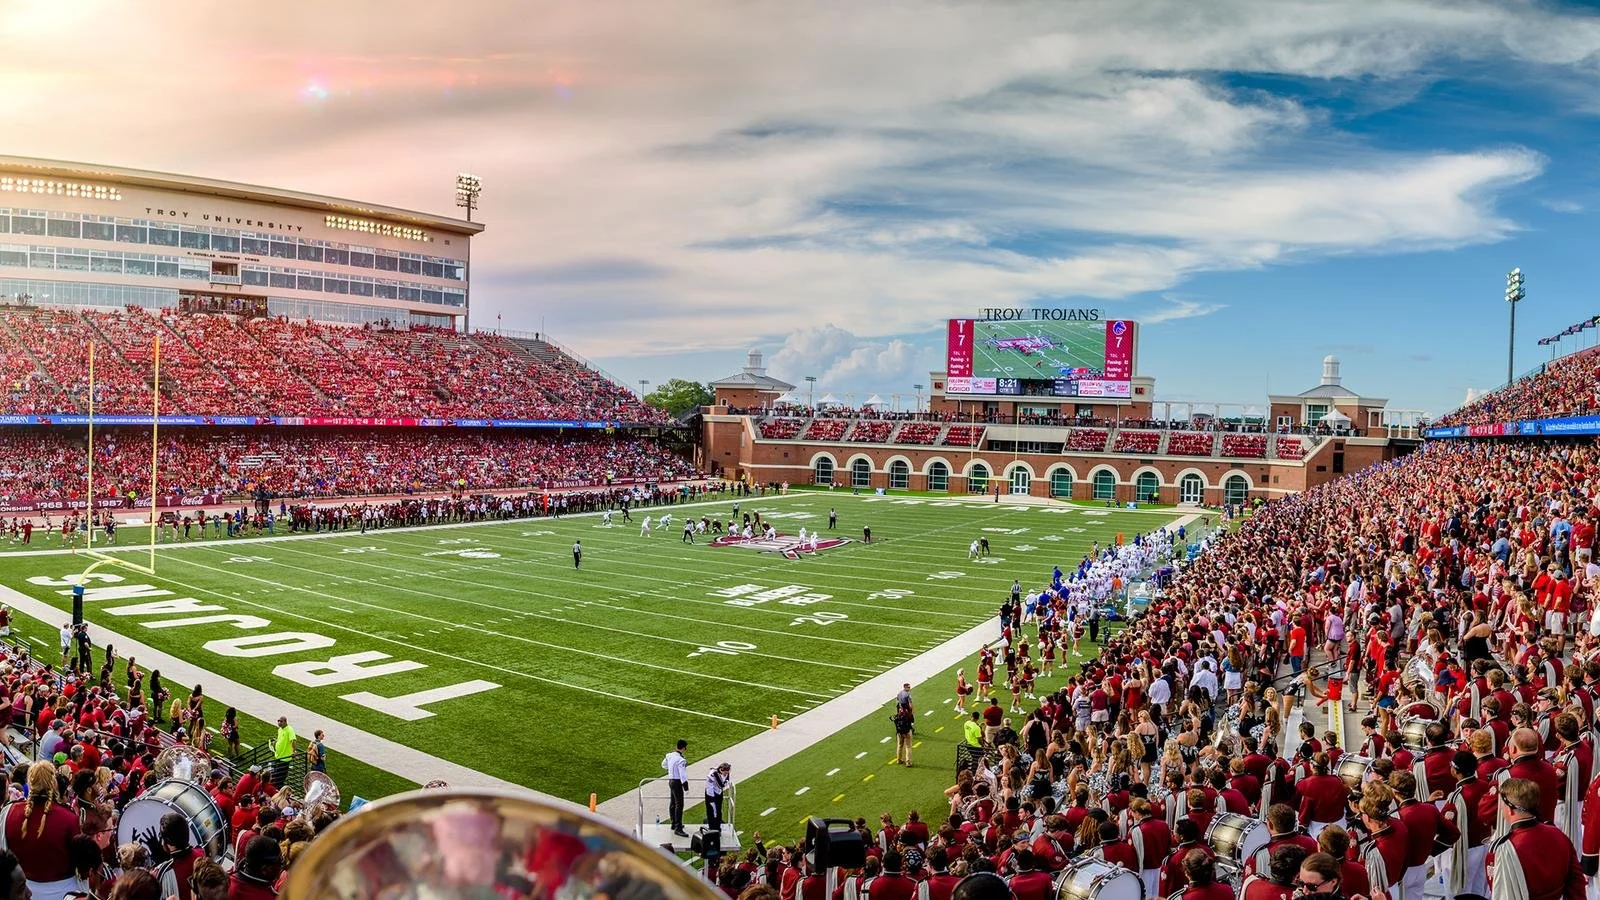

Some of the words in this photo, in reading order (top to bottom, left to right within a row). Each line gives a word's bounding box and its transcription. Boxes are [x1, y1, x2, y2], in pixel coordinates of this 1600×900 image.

[145, 208, 189, 218] TROY
[203, 214, 303, 232] UNIVERSITY
[984, 308, 1023, 320] TROY
[1032, 308, 1099, 320] TROJANS
[958, 334, 965, 346] 7
[1115, 336, 1123, 348] 7
[999, 379, 1017, 388] 8:21
[36, 501, 62, 509] 1968
[181, 496, 204, 506] Coca-Cola
[867, 588, 915, 600] 30
[789, 611, 849, 627] 20
[25, 572, 502, 721] TROJANS
[686, 641, 758, 658] 10
